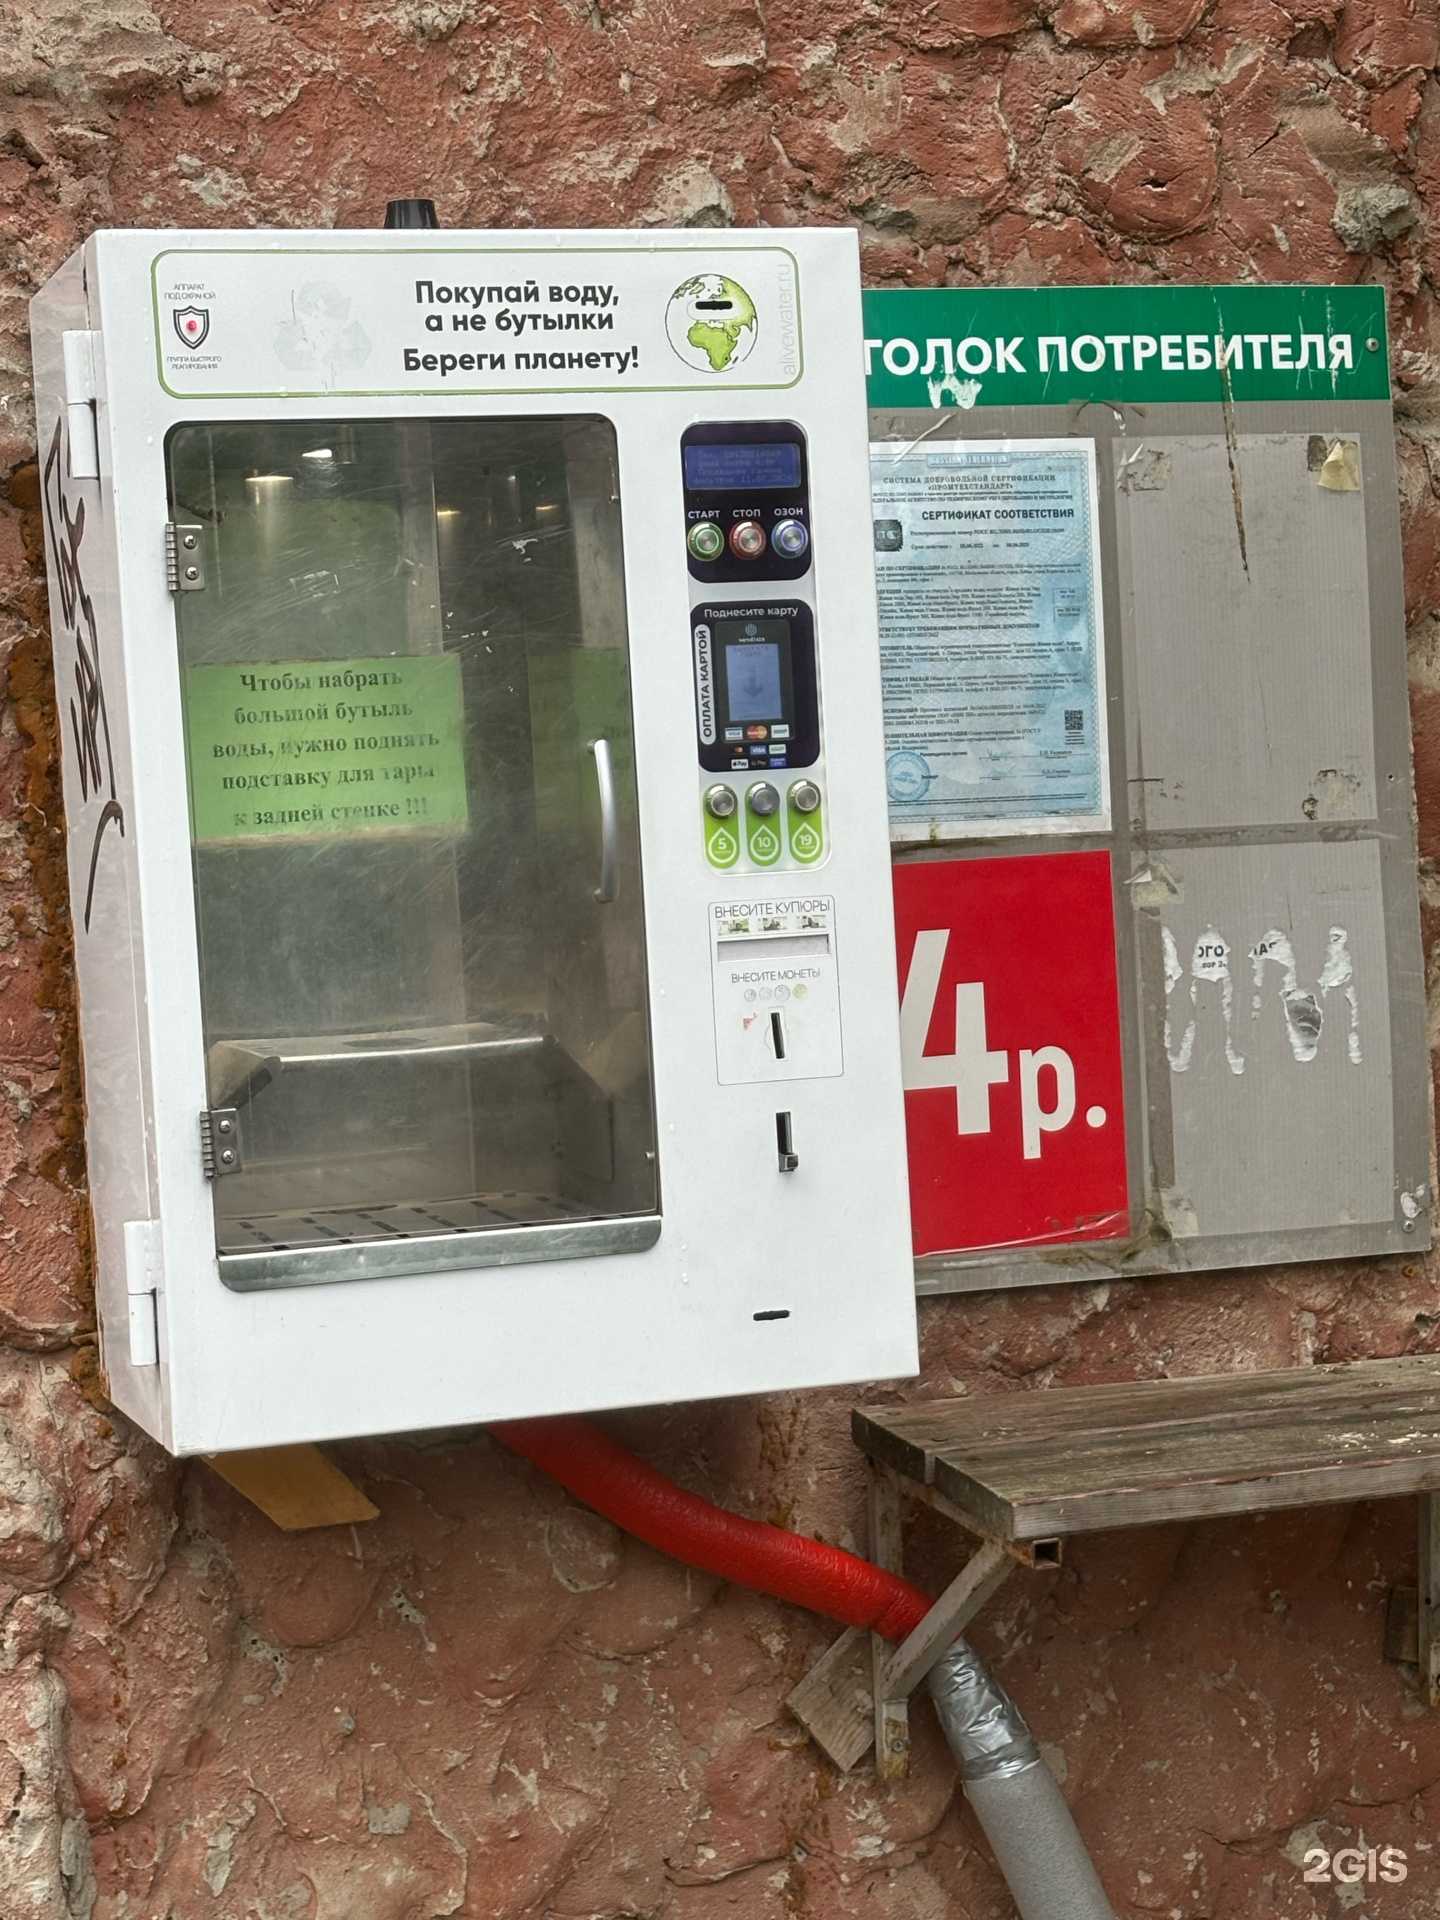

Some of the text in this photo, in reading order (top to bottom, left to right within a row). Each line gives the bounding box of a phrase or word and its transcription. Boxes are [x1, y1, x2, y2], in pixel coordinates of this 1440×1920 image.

[415, 280, 619, 309] Покупай воду,
[424, 308, 614, 337] а не бутылки
[403, 345, 639, 376] Береги планету!
[1037, 334, 1353, 373] ПОТРЕБИТЕЛЯ
[687, 507, 803, 519] СТАРТ СТОП ОЗОН
[922, 508, 1074, 521] СЕРТИФИКАТ СООТВЕТСТВИЯ
[704, 607, 799, 618] Поднесите карту
[240, 670, 403, 692] Чтобы набрать
[696, 629, 712, 738] ОПЛАТА КАРТОЙ
[234, 701, 413, 724] большой бутыль
[213, 732, 440, 760] воды, нужно поднять
[222, 770, 330, 791] подставку
[337, 768, 375, 785] для
[255, 804, 324, 825] задней
[331, 801, 400, 820] стенке
[718, 839, 727, 850] 5
[757, 836, 771, 848] 10
[714, 899, 830, 919] ВНЕСИТЕ КУПЮРЫ
[731, 968, 821, 984] ВНЕСИТЕ МОНЕТЫ
